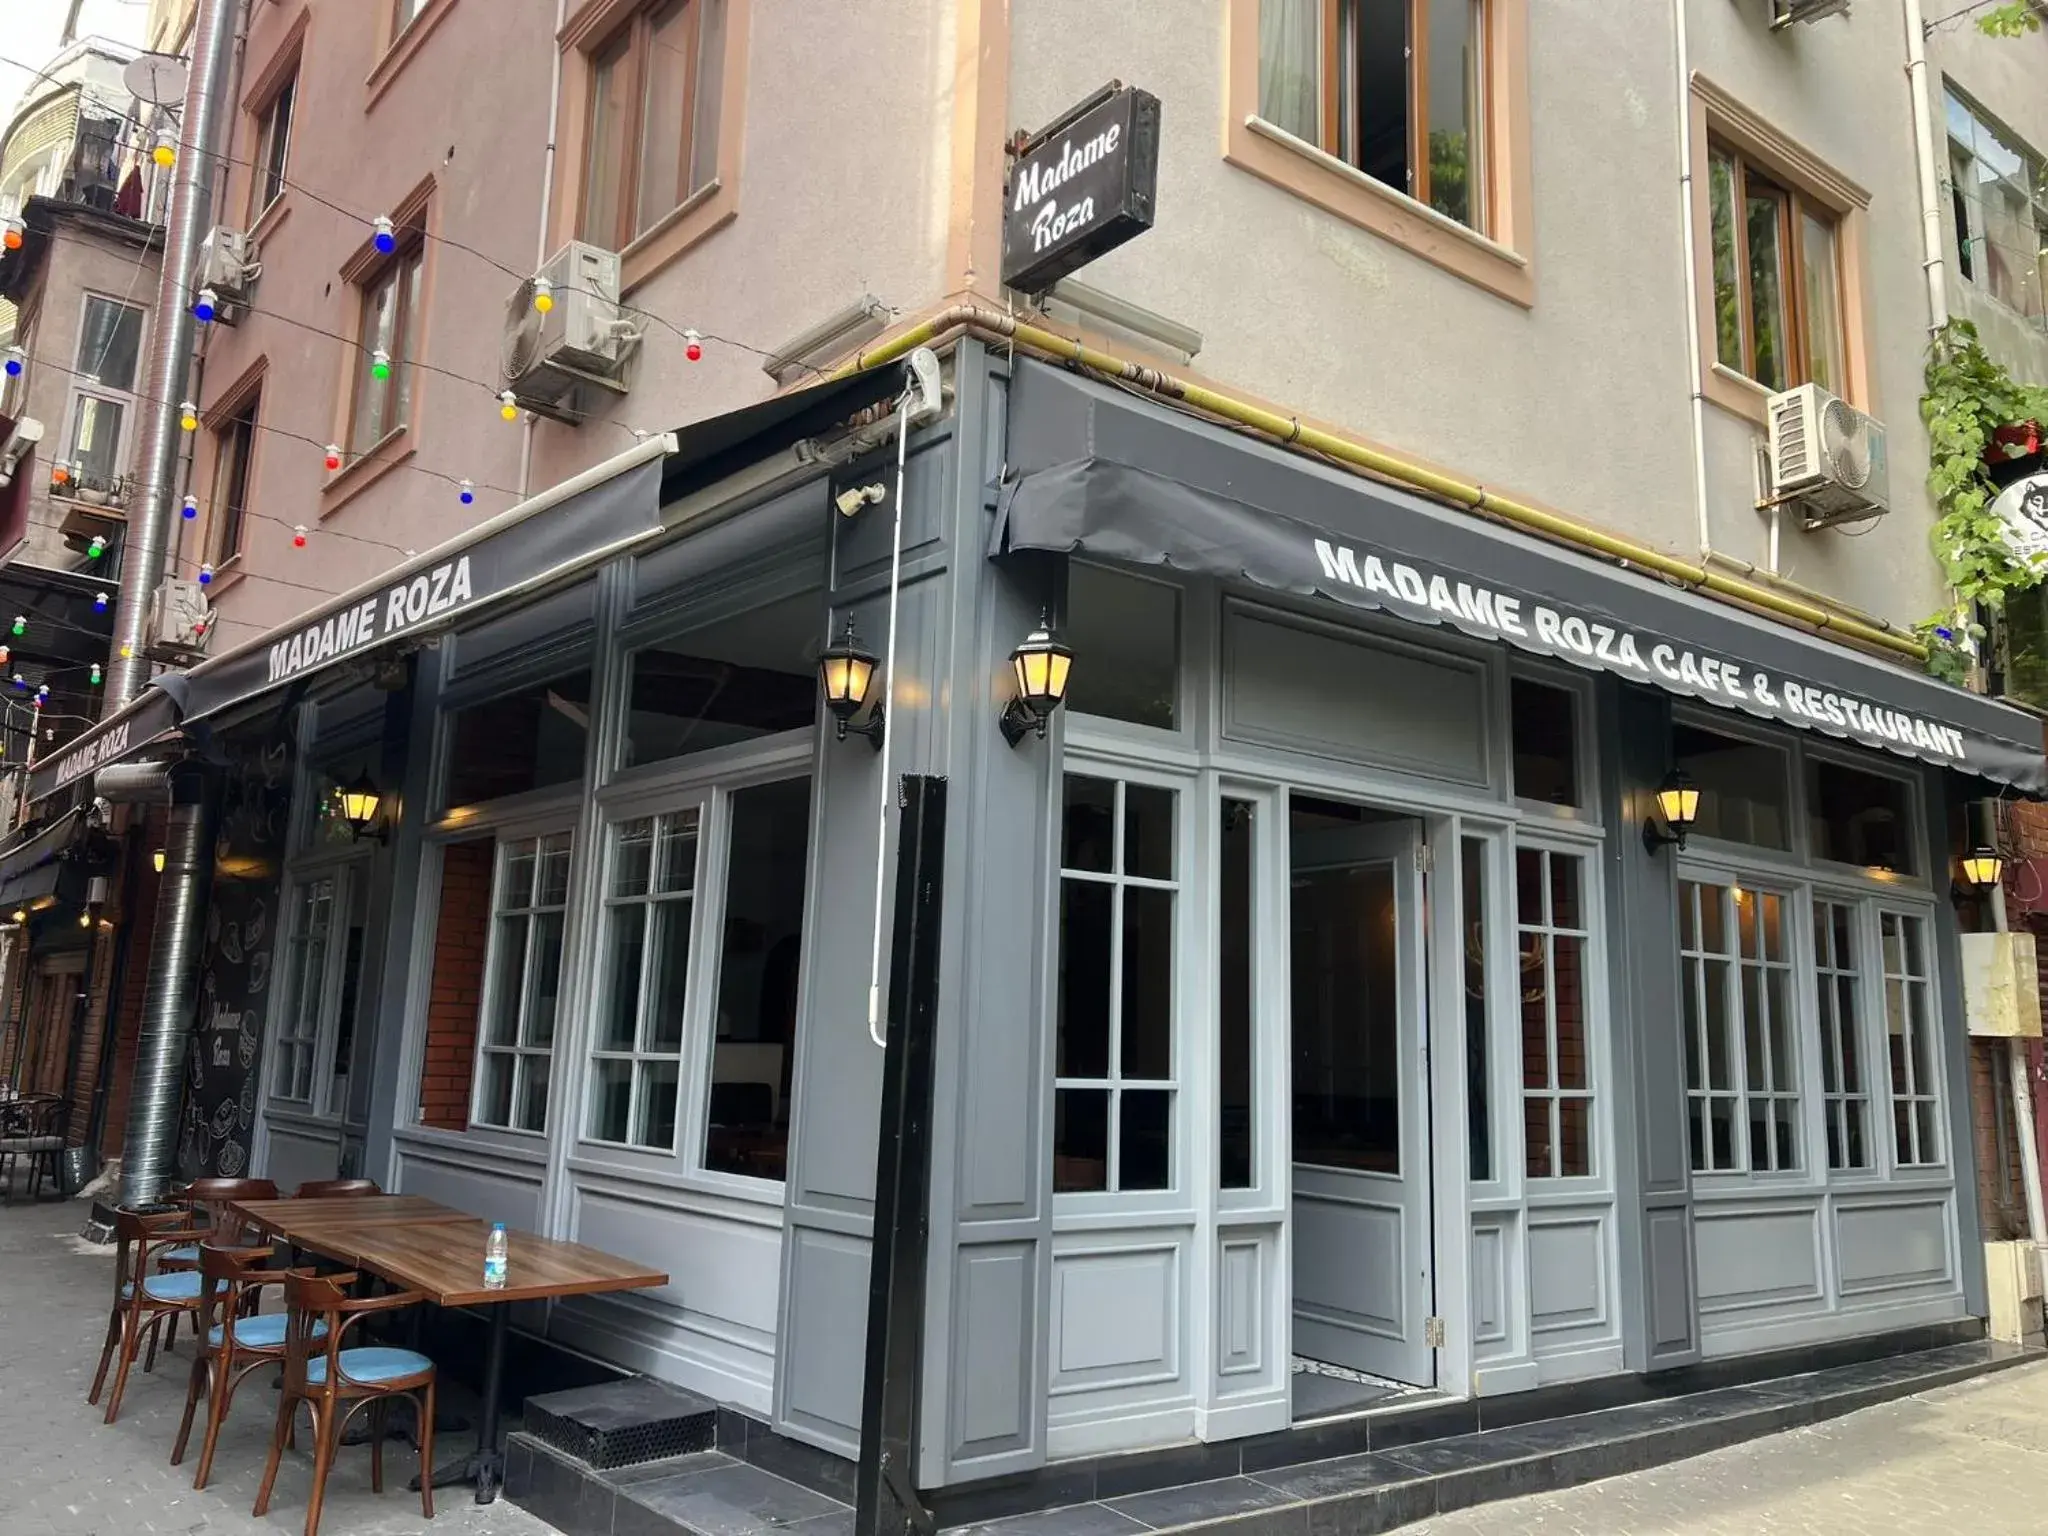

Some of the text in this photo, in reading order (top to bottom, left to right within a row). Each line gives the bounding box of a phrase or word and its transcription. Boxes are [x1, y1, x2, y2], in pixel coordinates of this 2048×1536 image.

[1014, 123, 1121, 212] Madame
[1031, 196, 1094, 252] Roza
[268, 555, 472, 682] MADAME ROZA
[1314, 538, 1965, 759] MADAME ROZA CAFE & RESTAURANT
[55, 721, 130, 786] MADAME ROZA
